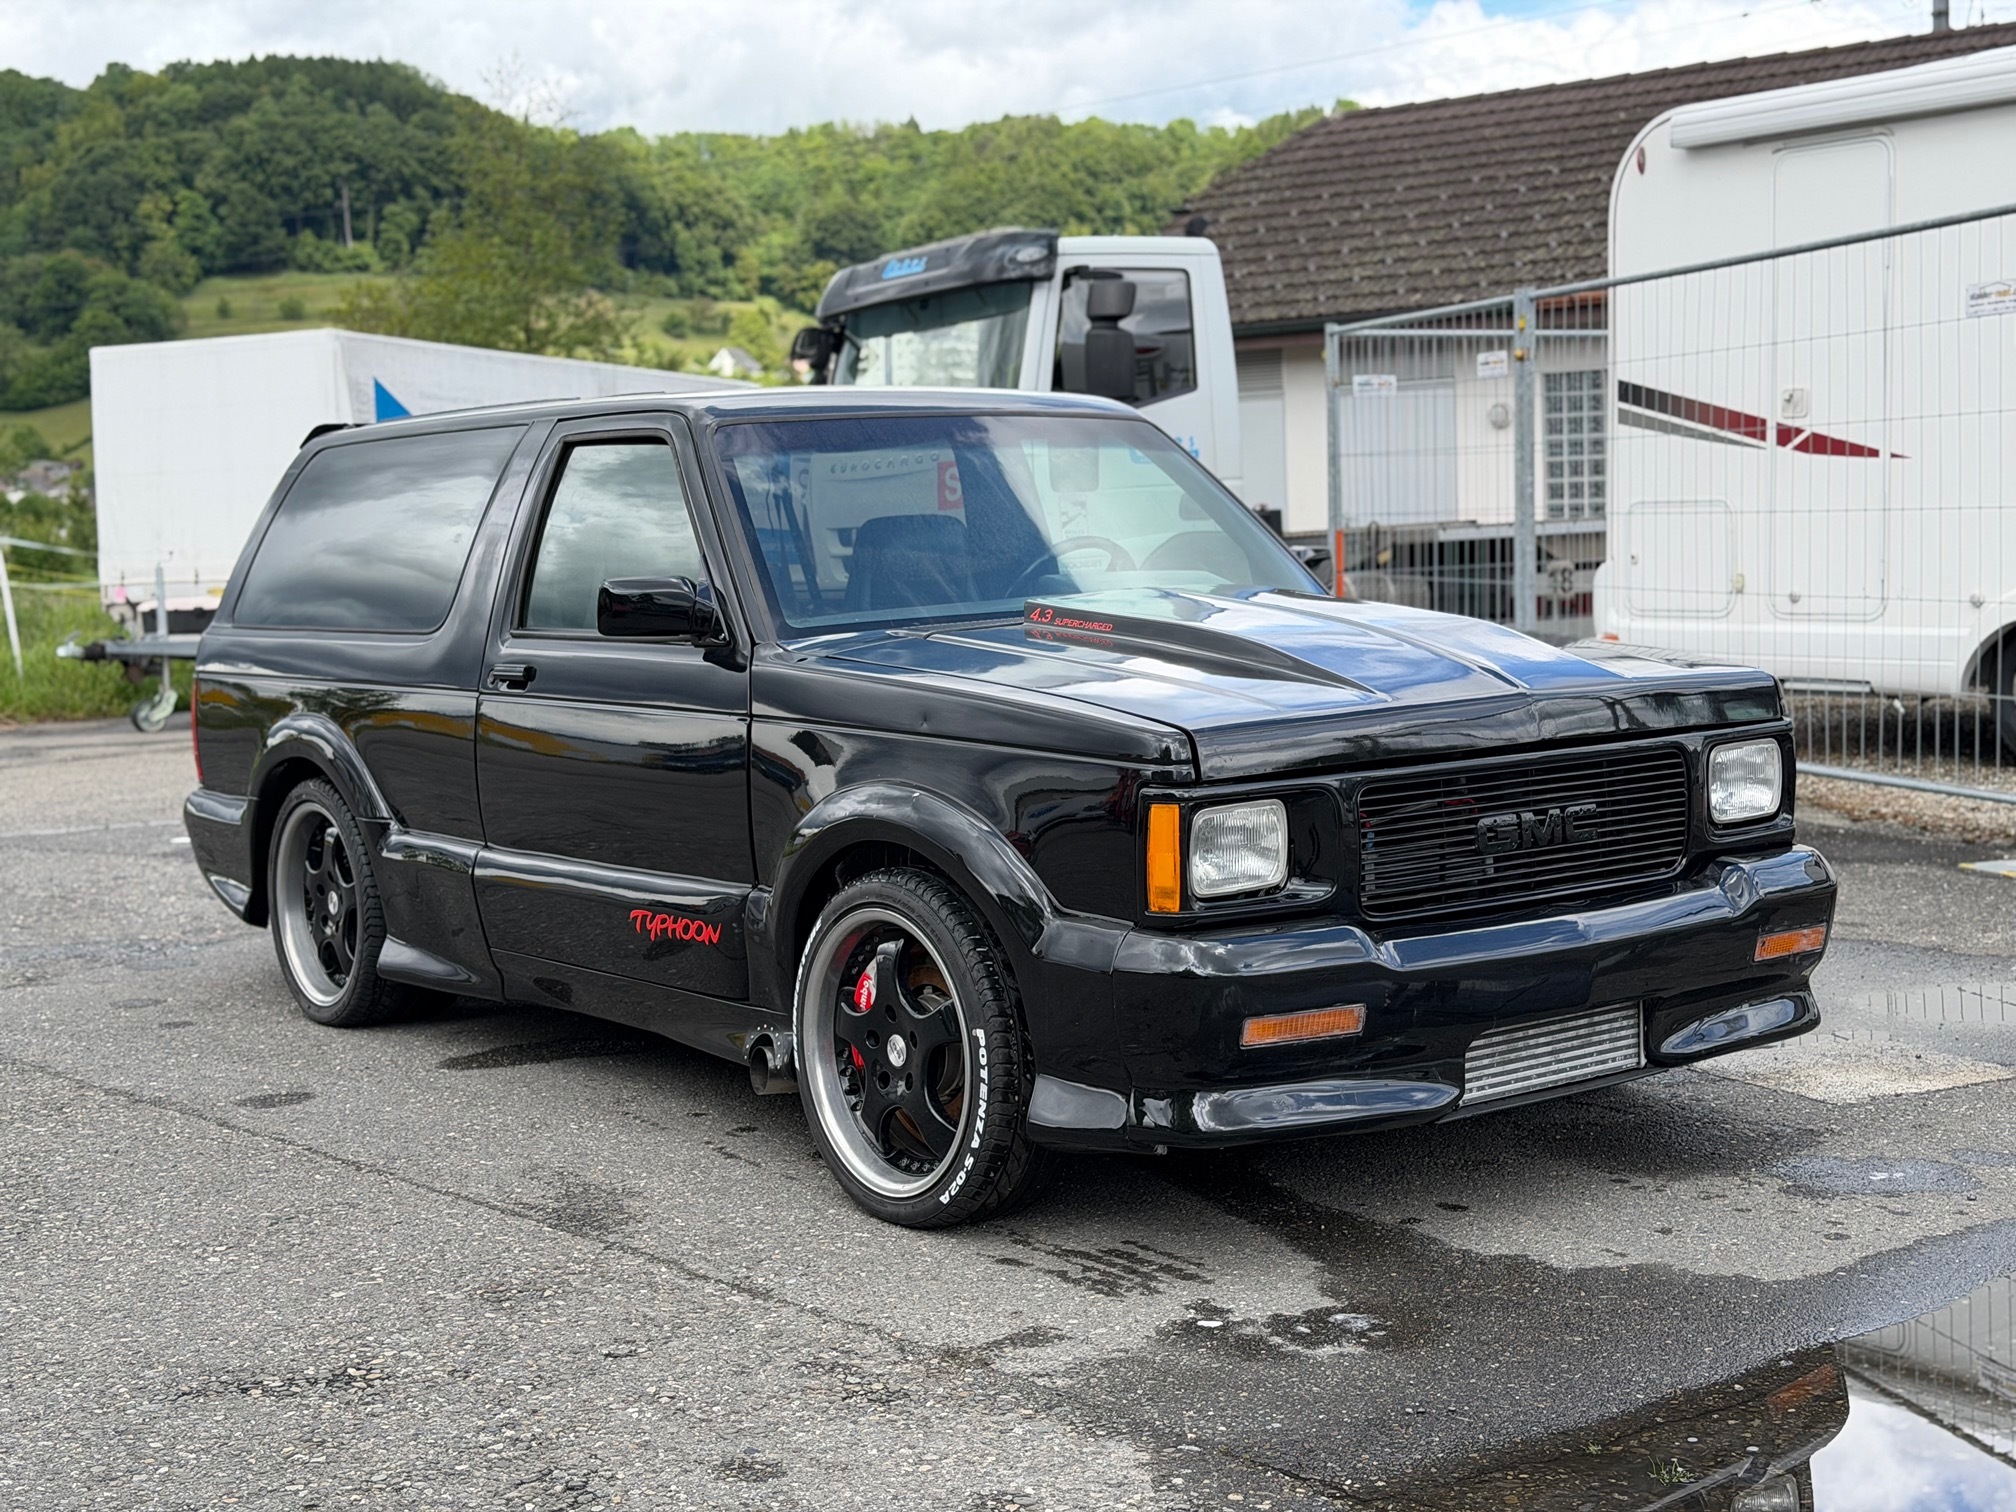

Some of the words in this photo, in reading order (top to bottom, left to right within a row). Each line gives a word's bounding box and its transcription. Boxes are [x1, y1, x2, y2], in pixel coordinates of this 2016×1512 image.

[829, 451, 940, 474] EUROCARGO
[1030, 607, 1053, 623] 4.3
[1054, 617, 1114, 632] SUPERCHARGED
[1476, 803, 1598, 854] GMC
[629, 909, 722, 946] TYPHOON
[970, 1028, 988, 1149] POTENZA
